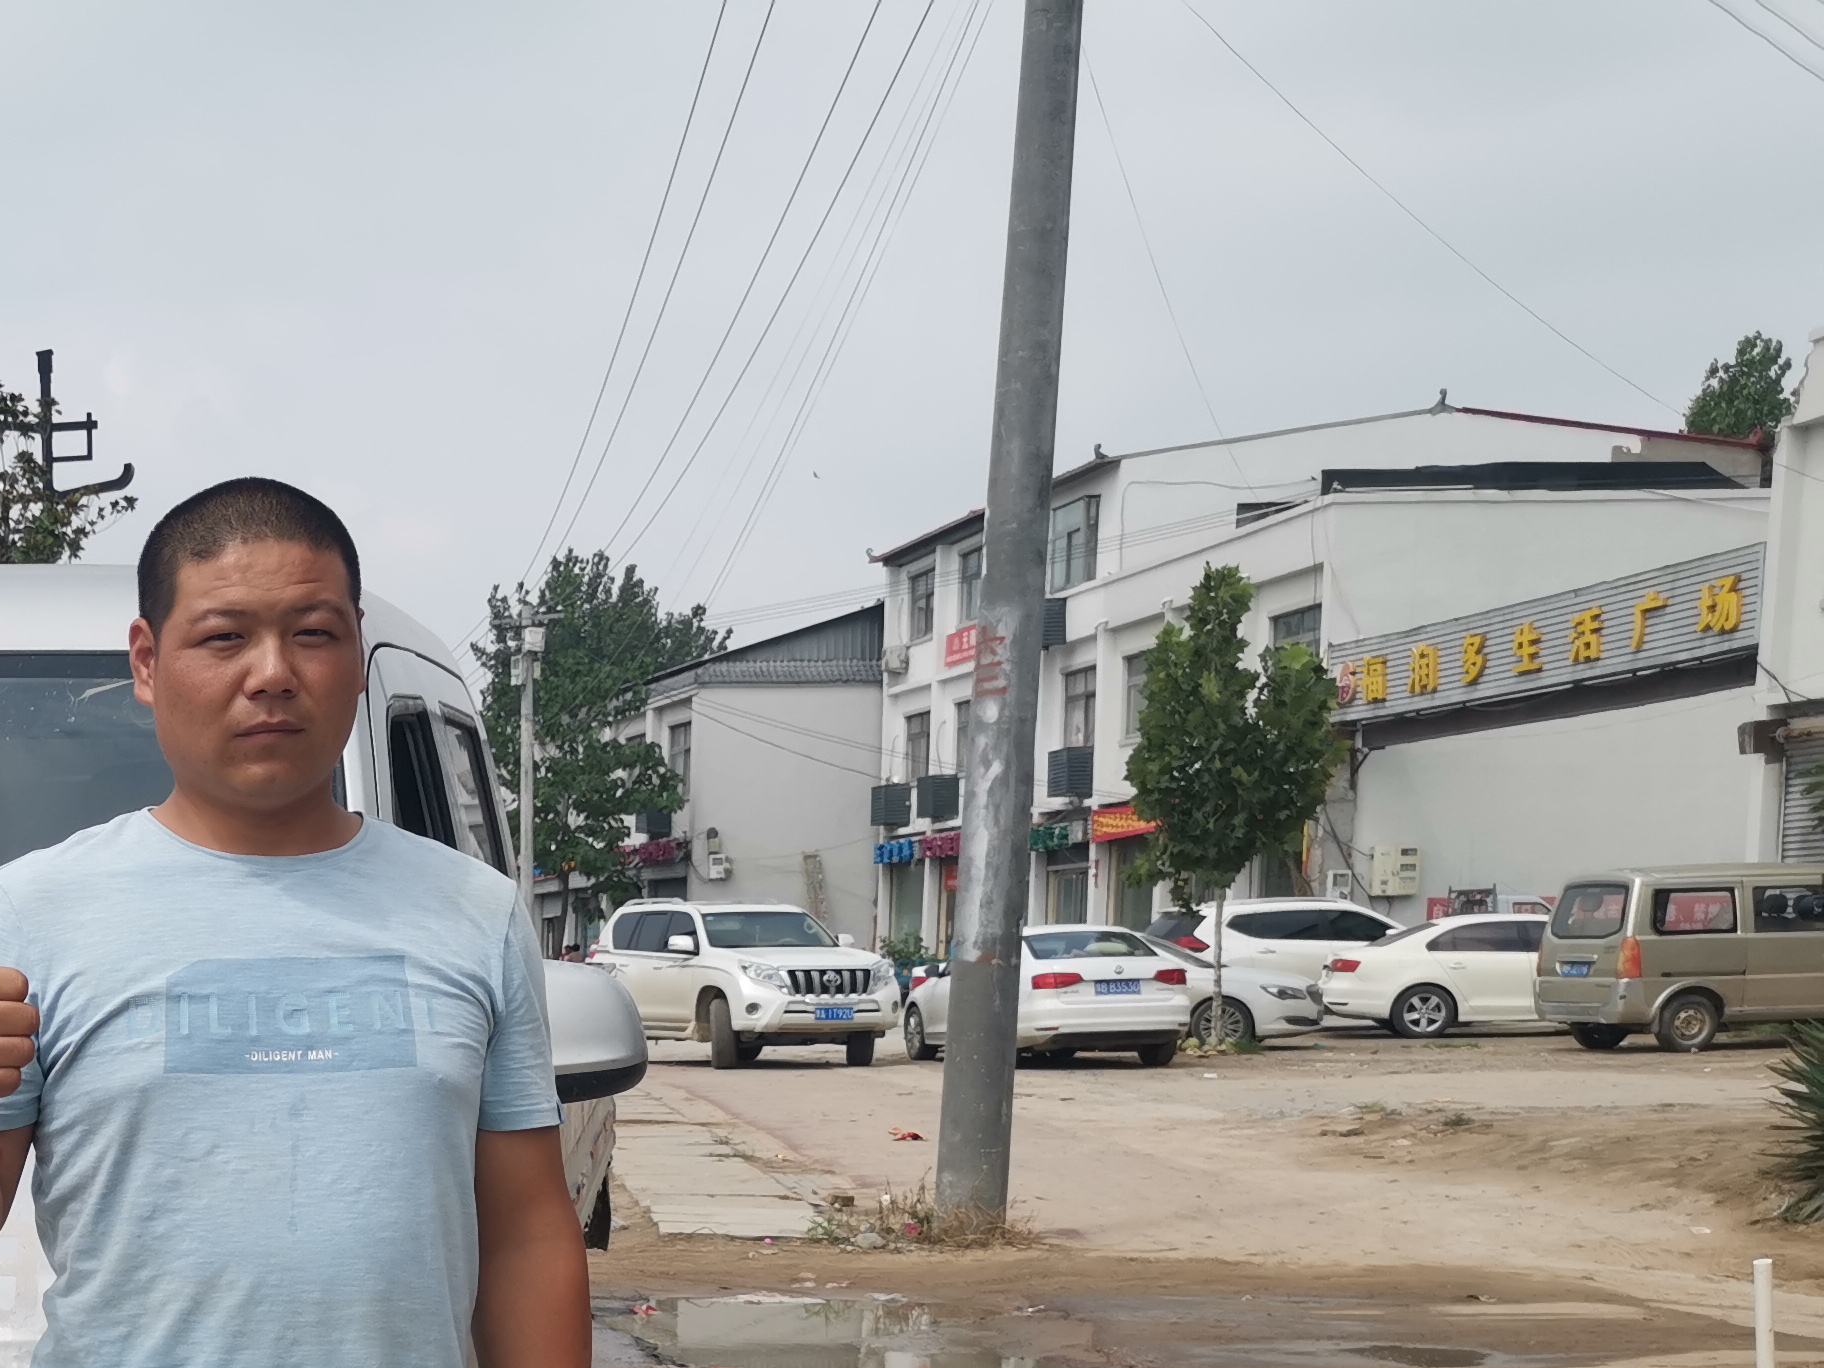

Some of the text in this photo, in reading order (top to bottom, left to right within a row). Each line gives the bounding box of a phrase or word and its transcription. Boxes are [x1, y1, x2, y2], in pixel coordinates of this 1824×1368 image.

[1360, 574, 1743, 704] 福润多生活广场
[125, 988, 440, 1040] DILIGENT
